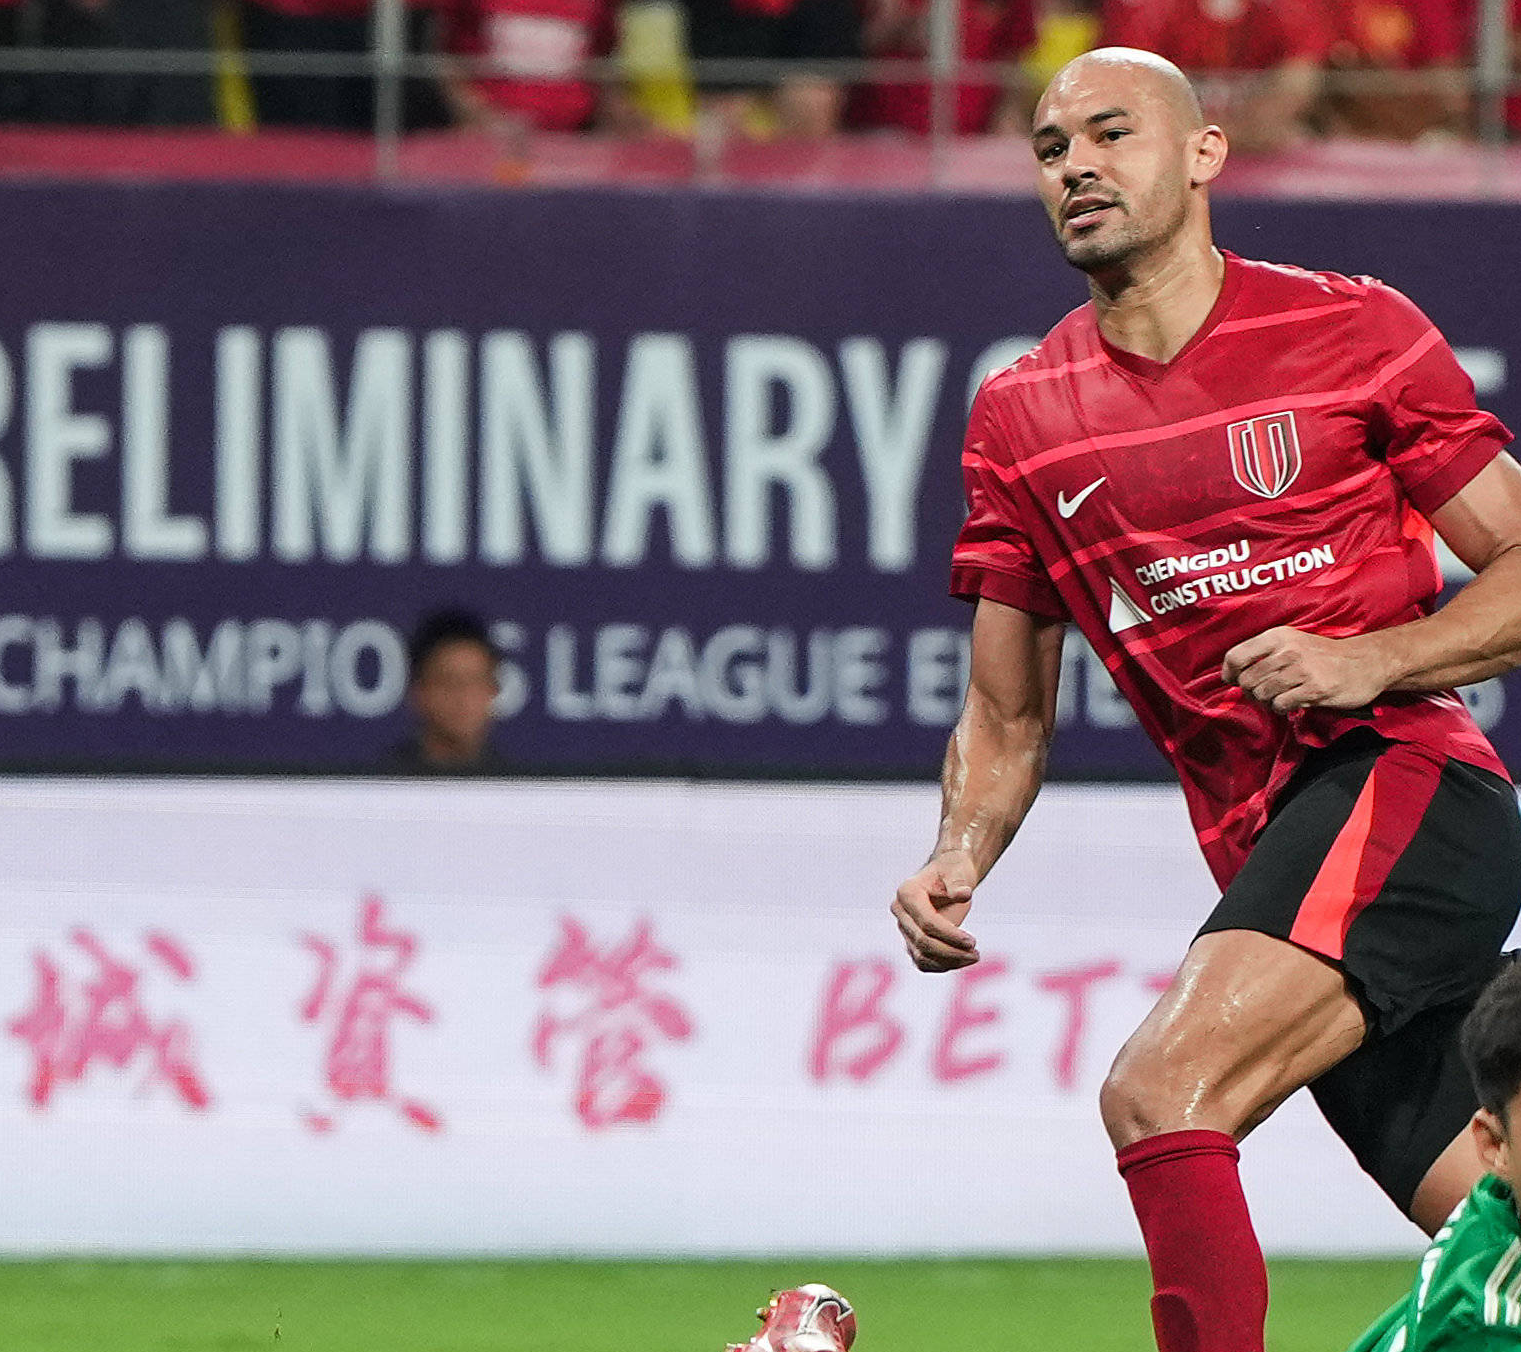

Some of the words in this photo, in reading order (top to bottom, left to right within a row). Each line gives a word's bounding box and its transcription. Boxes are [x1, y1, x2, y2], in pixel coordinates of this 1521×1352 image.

[1135, 539, 1251, 586] CHENGDU
[1150, 544, 1335, 615] CONSTRUCTION
[546, 624, 888, 725] LEAGUE
